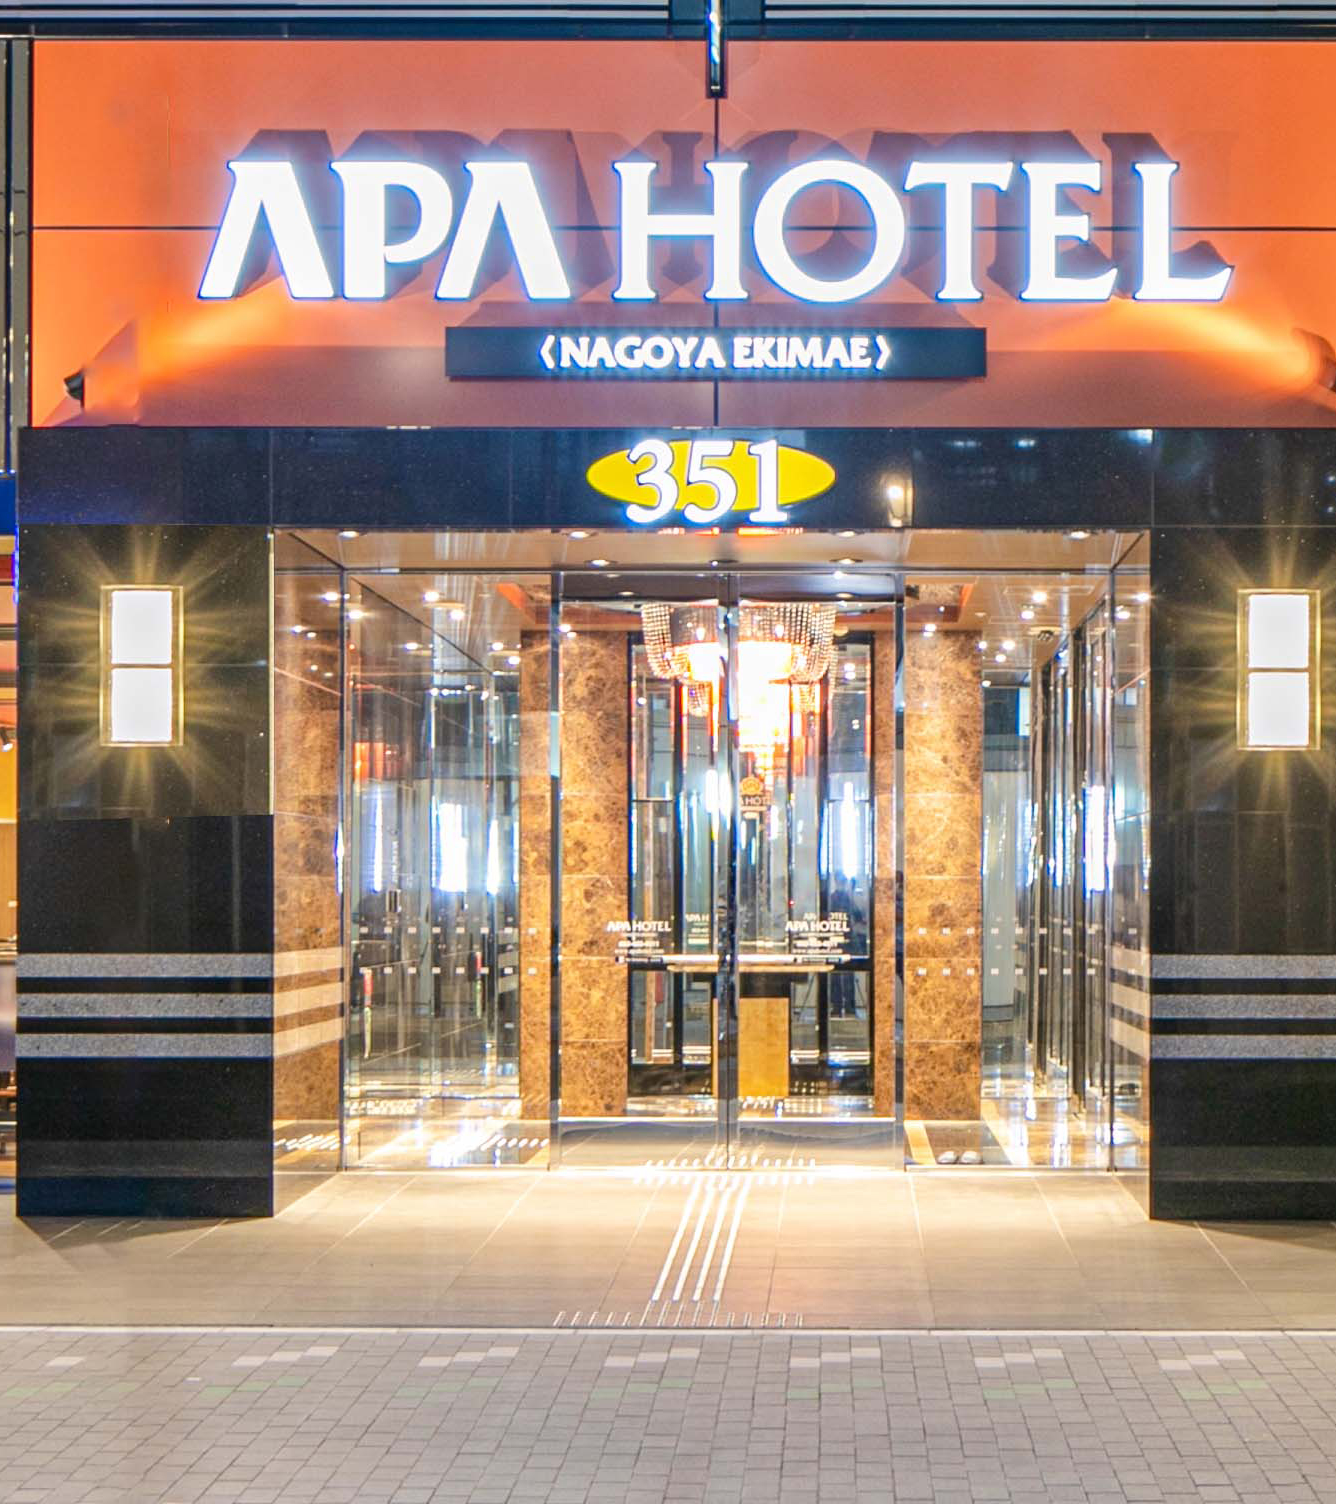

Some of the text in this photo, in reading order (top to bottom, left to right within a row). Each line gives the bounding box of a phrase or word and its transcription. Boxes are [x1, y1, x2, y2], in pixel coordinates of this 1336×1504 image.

[197, 159, 1234, 302] APA HOTEL
[625, 438, 788, 524] 351
[606, 920, 672, 932] APA HOTEL
[784, 920, 850, 932] APA HOTEL
